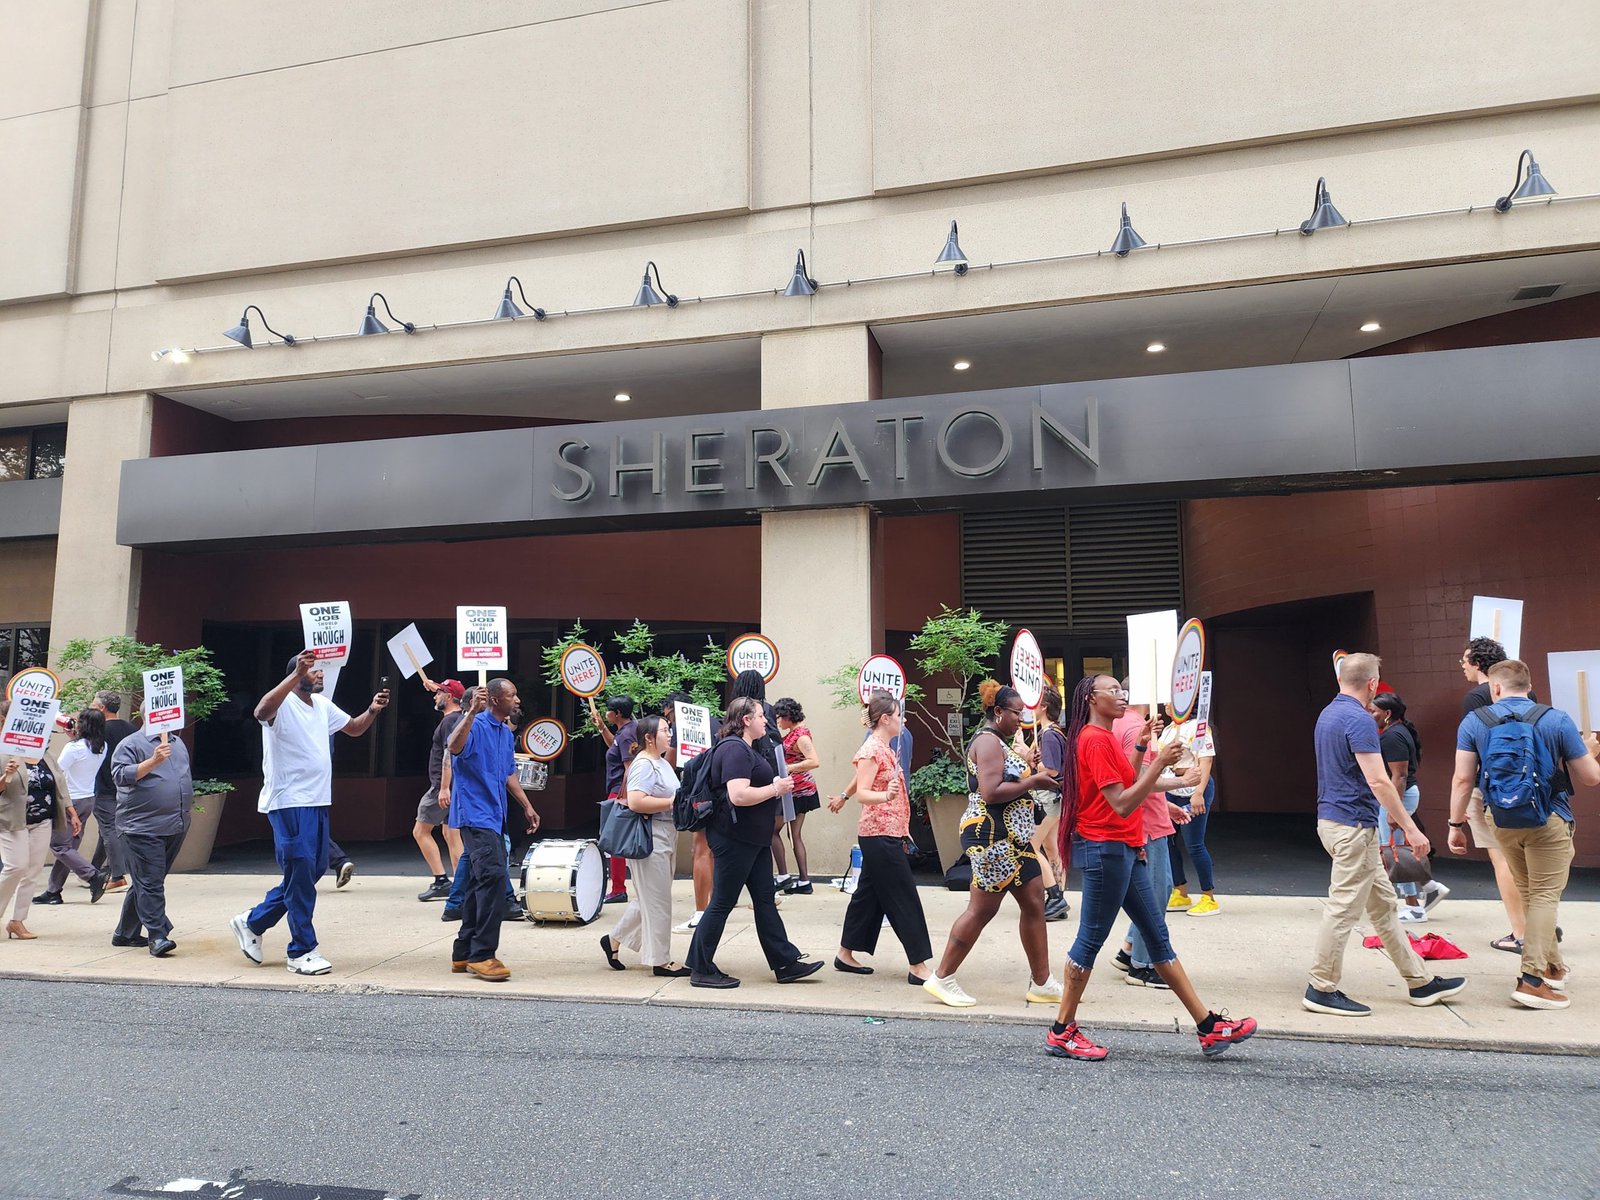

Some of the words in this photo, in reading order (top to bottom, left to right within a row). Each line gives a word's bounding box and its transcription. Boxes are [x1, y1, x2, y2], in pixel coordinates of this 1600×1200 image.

[551, 396, 1100, 502] SHERATON
[309, 606, 341, 616] ONE
[465, 609, 497, 617] ONE
[312, 629, 344, 646] ENOUGH
[465, 631, 499, 645] ENOUGH
[739, 652, 768, 660] UNITE
[739, 660, 768, 669] HERE!
[1177, 653, 1199, 673] UNITE
[567, 657, 595, 676] UNITE
[150, 671, 175, 682] ONE
[154, 680, 174, 688] JOB
[572, 666, 599, 685] HERE!
[864, 670, 901, 687] UNITE
[1014, 662, 1040, 694] UNITE
[19, 679, 52, 695] UNITE
[20, 698, 51, 709] ONE
[151, 693, 177, 710] ENOUGH
[681, 706, 703, 718] ONE
[11, 718, 46, 735] ENOUGH
[530, 732, 553, 752] HERE!
[536, 726, 559, 746] UNITE
[682, 728, 706, 745] ENOUGH
